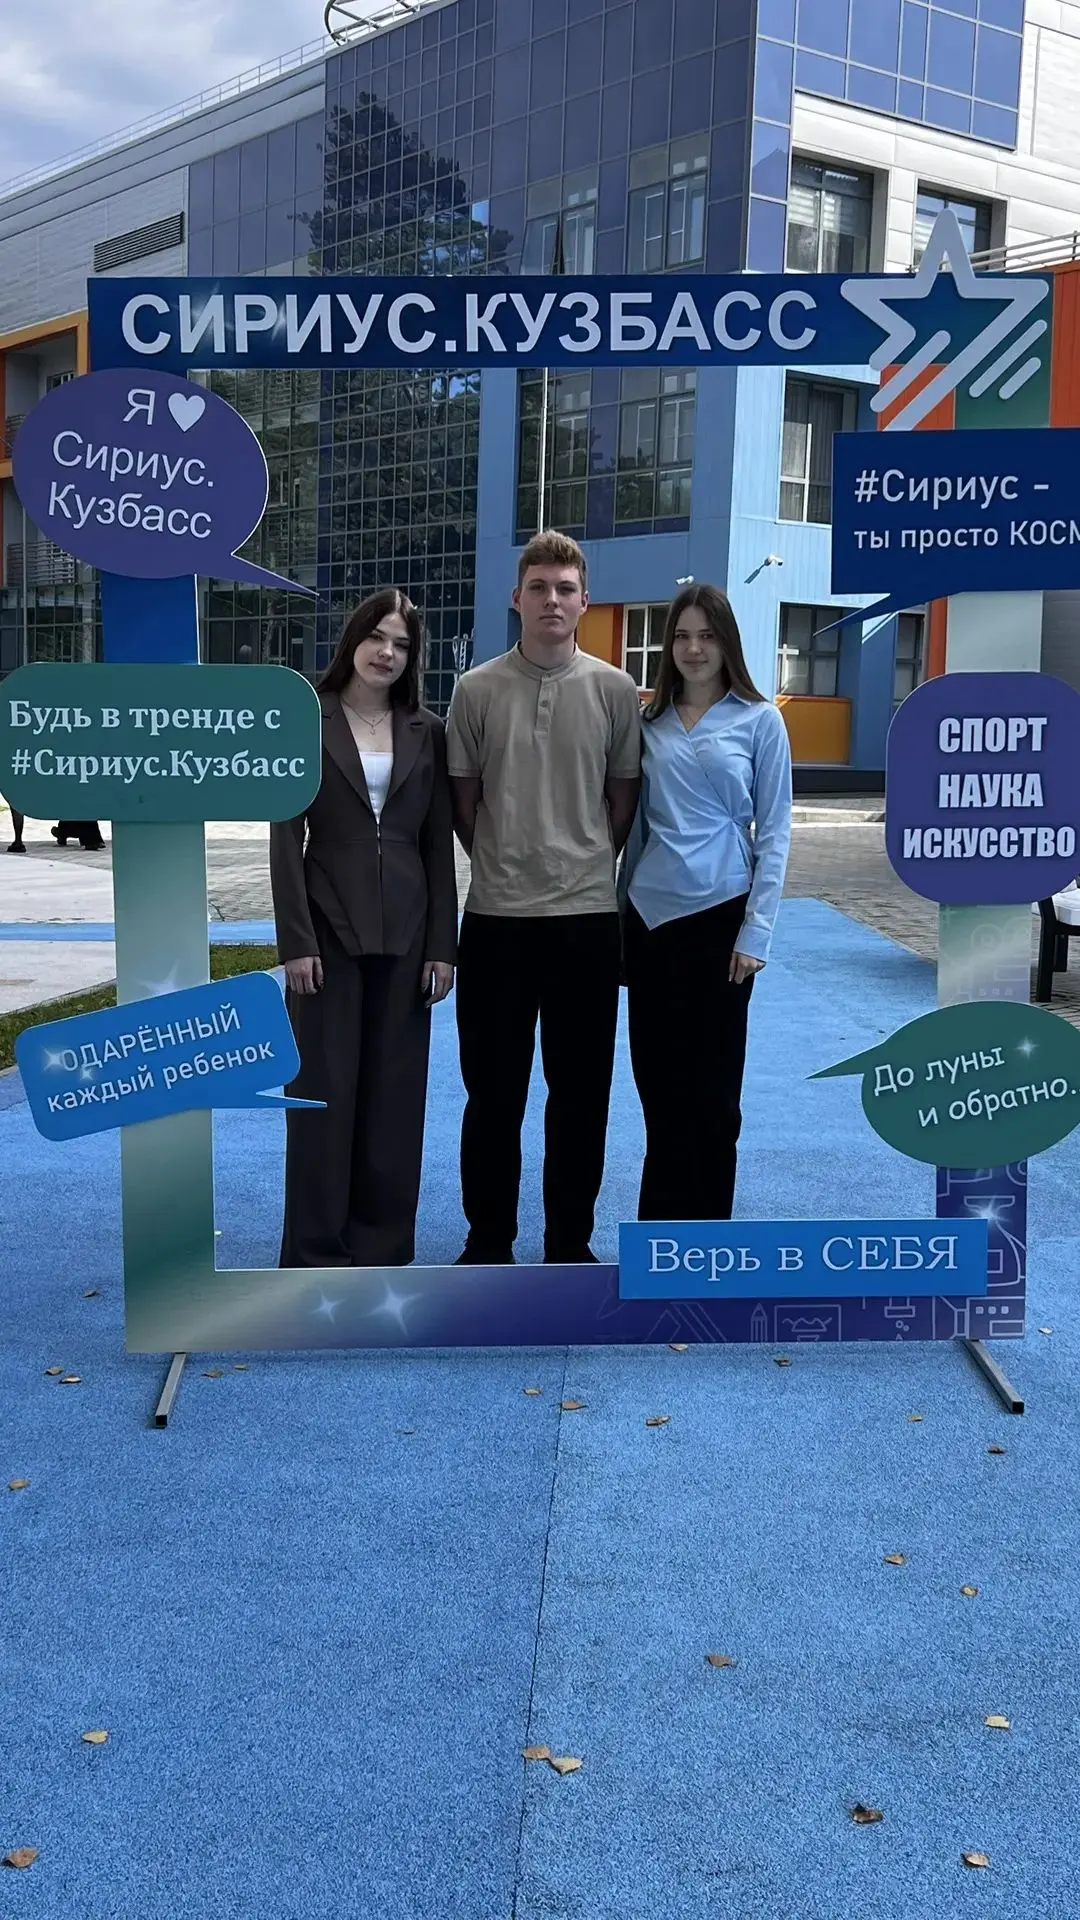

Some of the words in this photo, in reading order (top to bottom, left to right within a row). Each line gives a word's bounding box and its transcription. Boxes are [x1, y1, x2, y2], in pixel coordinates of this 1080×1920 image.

[121, 289, 819, 354] СИРИУС.КУЗБАСС
[123, 388, 156, 426] Я
[52, 430, 214, 490] Сириус.
[854, 469, 1019, 510] #Сириус
[48, 481, 213, 538] Кузбасс
[854, 530, 890, 549] ты
[901, 528, 999, 554] просто
[9, 700, 92, 734] Будь
[101, 707, 121, 729] в
[129, 707, 255, 736] тренде
[264, 708, 281, 729] с
[938, 717, 1048, 753] СПОРТ
[11, 748, 306, 784] #Сириус.Кузбасс
[938, 773, 1044, 808] НАУКА
[903, 826, 1076, 858] ИСКУССТВО
[60, 1002, 241, 1072] ОДАРЁННЫЙ
[47, 1065, 155, 1112] каждый
[162, 1041, 275, 1089] ребенок
[874, 1064, 915, 1096] До
[925, 1047, 1005, 1084] луны
[918, 1107, 939, 1127] и
[648, 1238, 761, 1281] Верь
[777, 1247, 804, 1271] в
[821, 1236, 959, 1271] СЕБЯ
